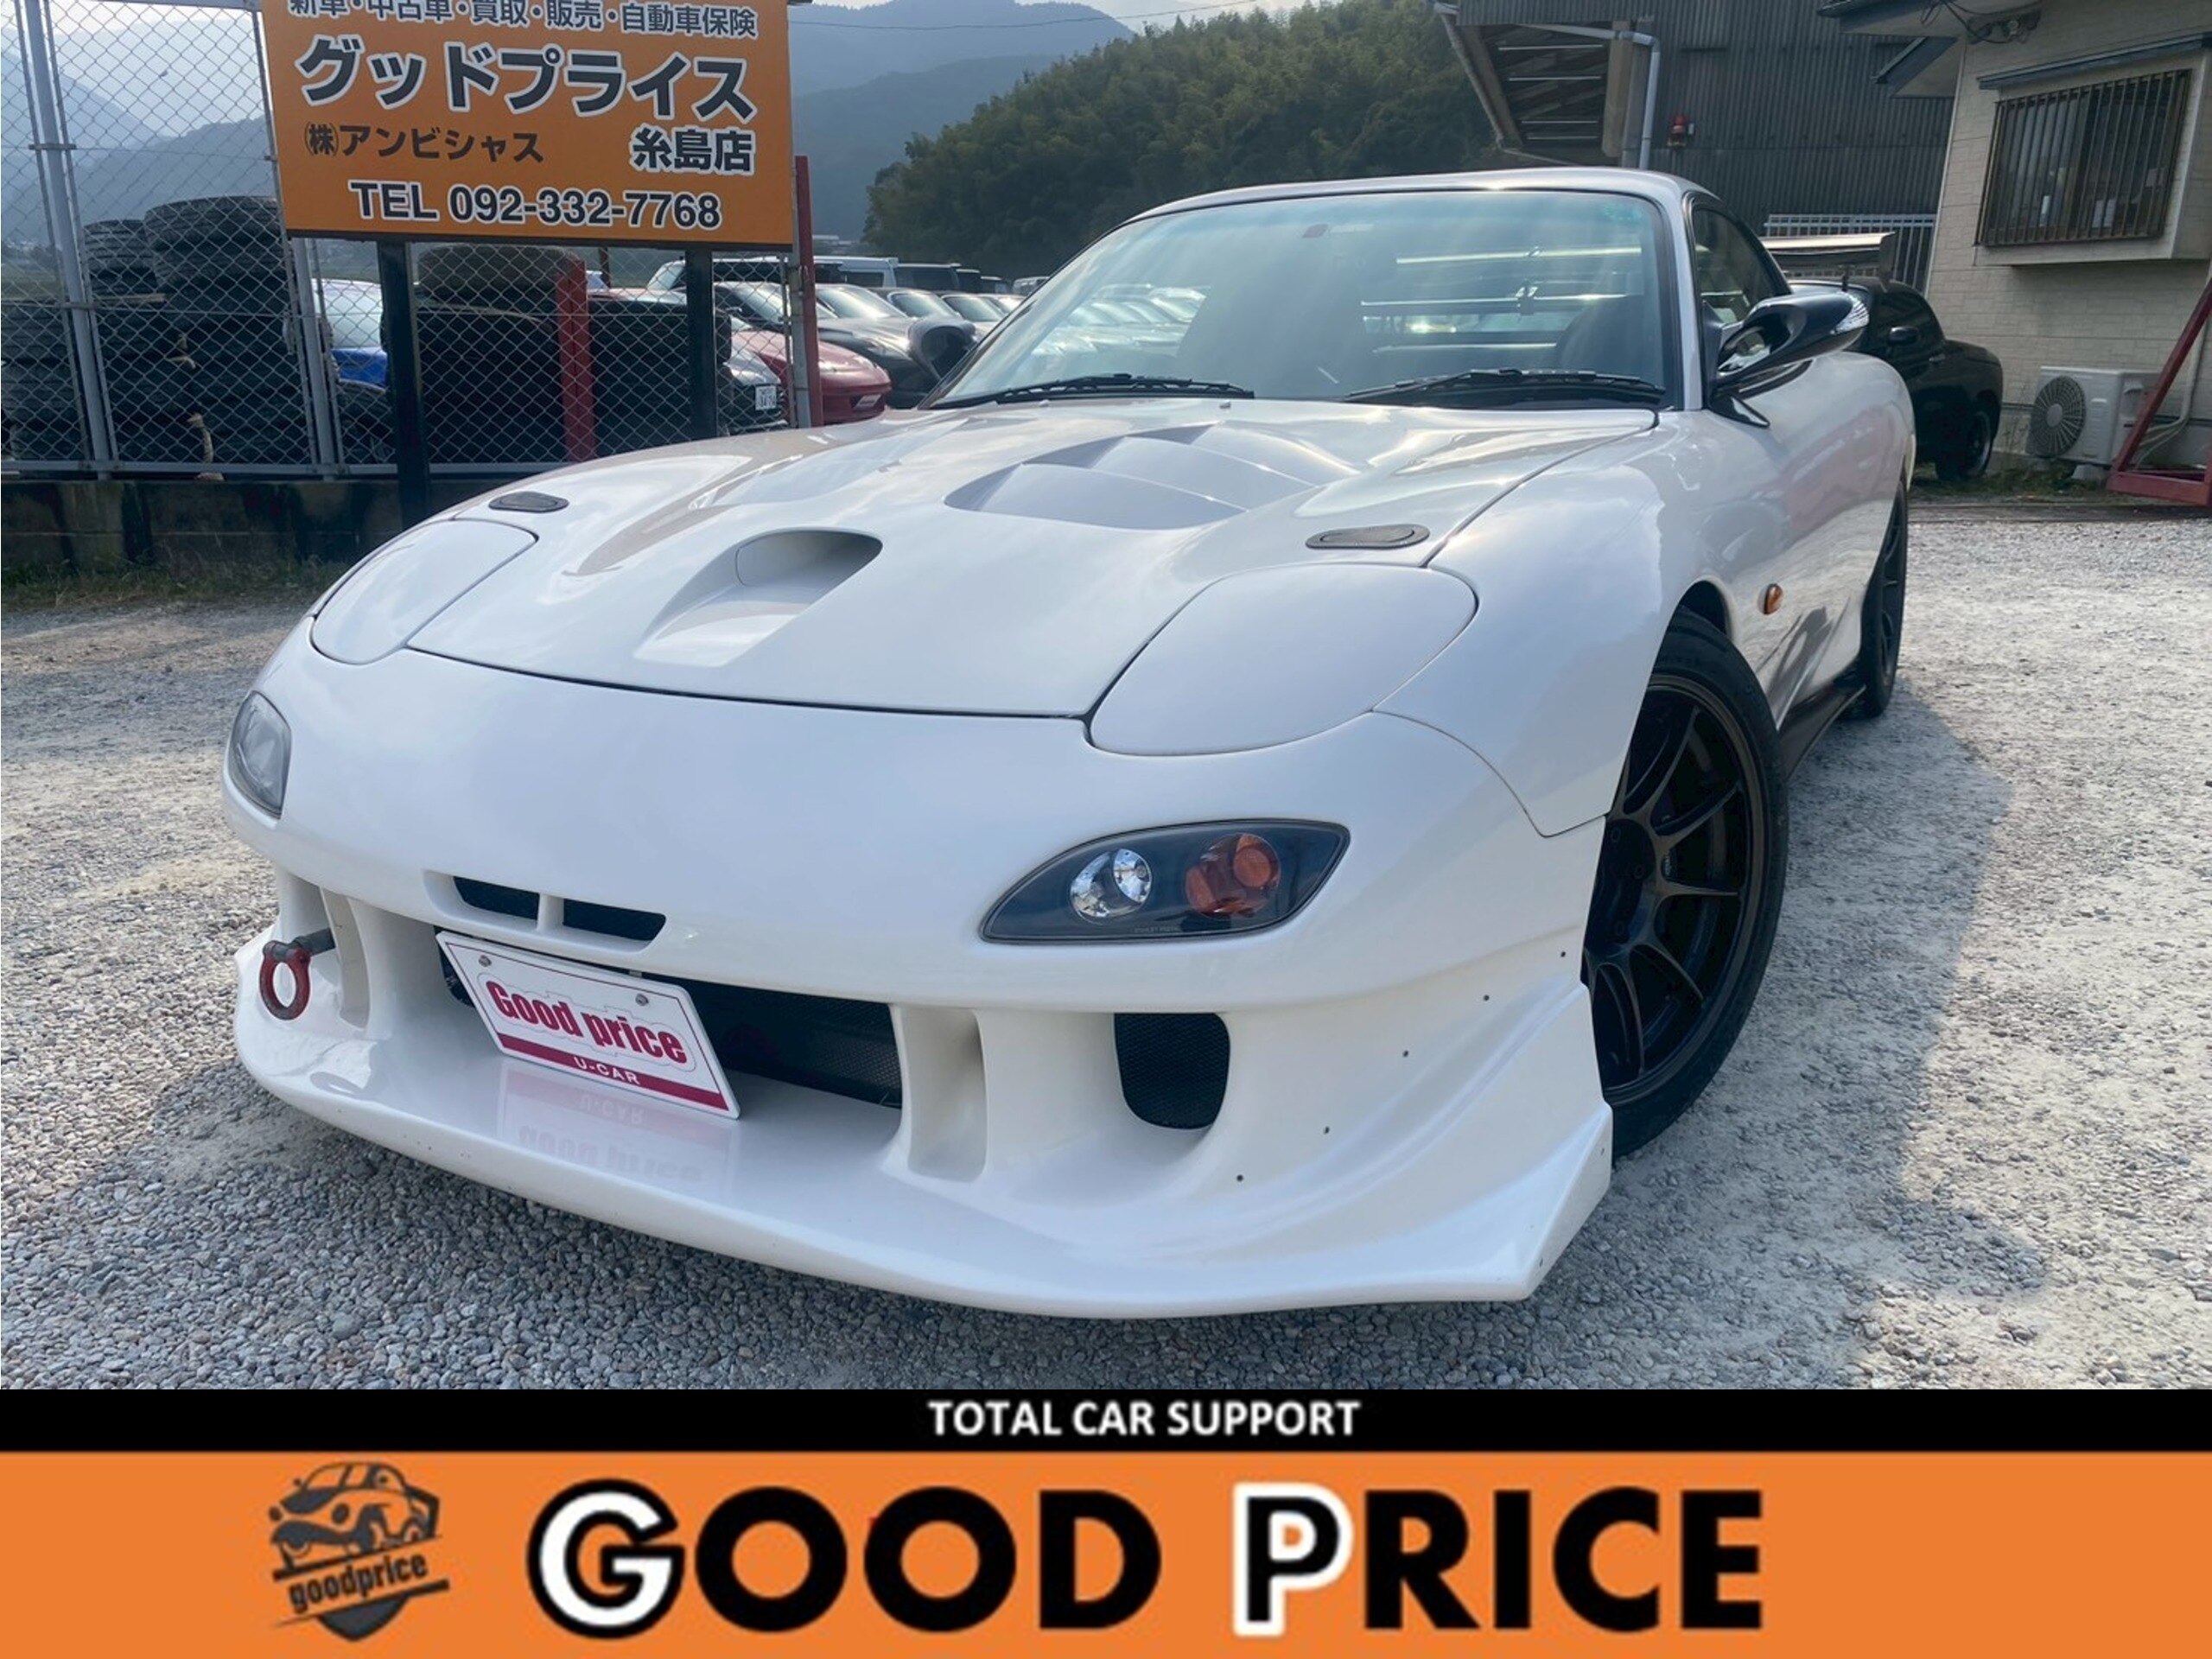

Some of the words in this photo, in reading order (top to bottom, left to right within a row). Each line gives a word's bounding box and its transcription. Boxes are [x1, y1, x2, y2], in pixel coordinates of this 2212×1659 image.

[296, 35, 756, 120] グッドプライス
[631, 124, 753, 173] 糸島店
[350, 181, 438, 220] TEL
[451, 185, 720, 227] 092-332-7768
[486, 980, 584, 1038] Good
[580, 1011, 688, 1065] price
[573, 1056, 641, 1085] U-CAR
